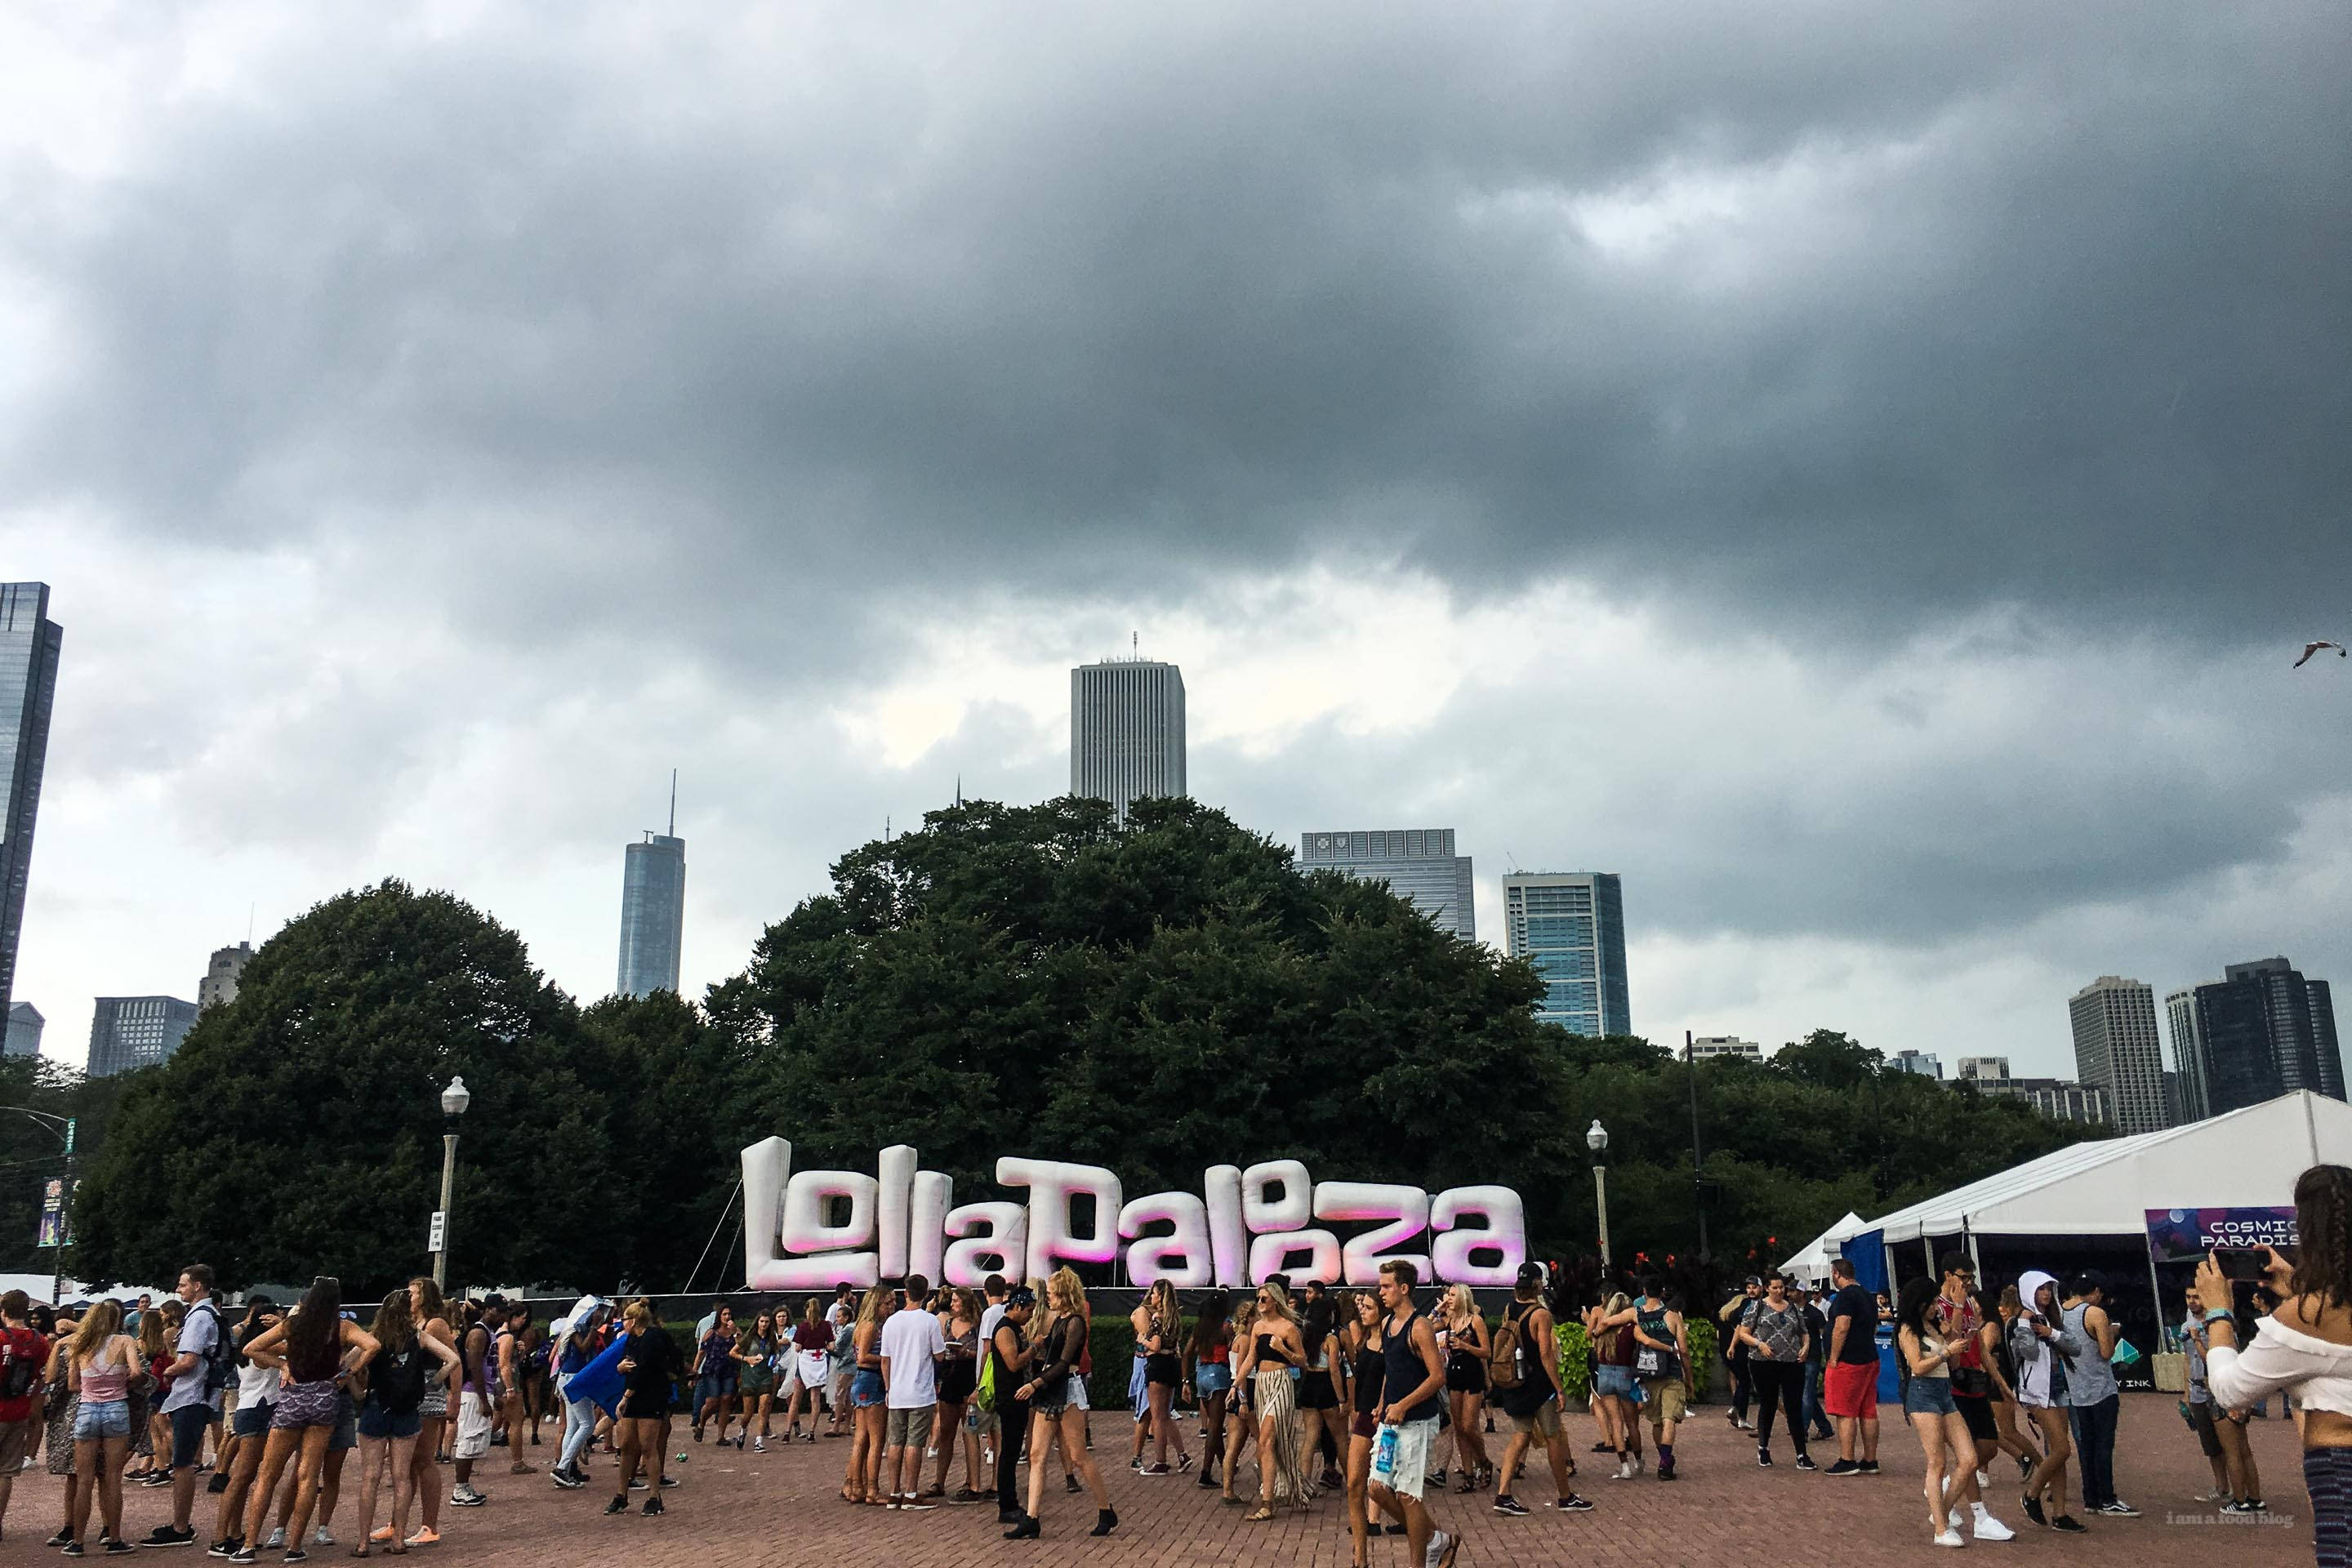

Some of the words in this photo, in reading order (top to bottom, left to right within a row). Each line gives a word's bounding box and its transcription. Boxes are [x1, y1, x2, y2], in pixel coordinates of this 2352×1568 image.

[741, 1136, 1526, 1290] Lollapalooza
[2210, 1220, 2298, 1234] COSMIC
[2200, 1233, 2301, 1247] PARADIS
[2126, 1379, 2151, 1388] INK
